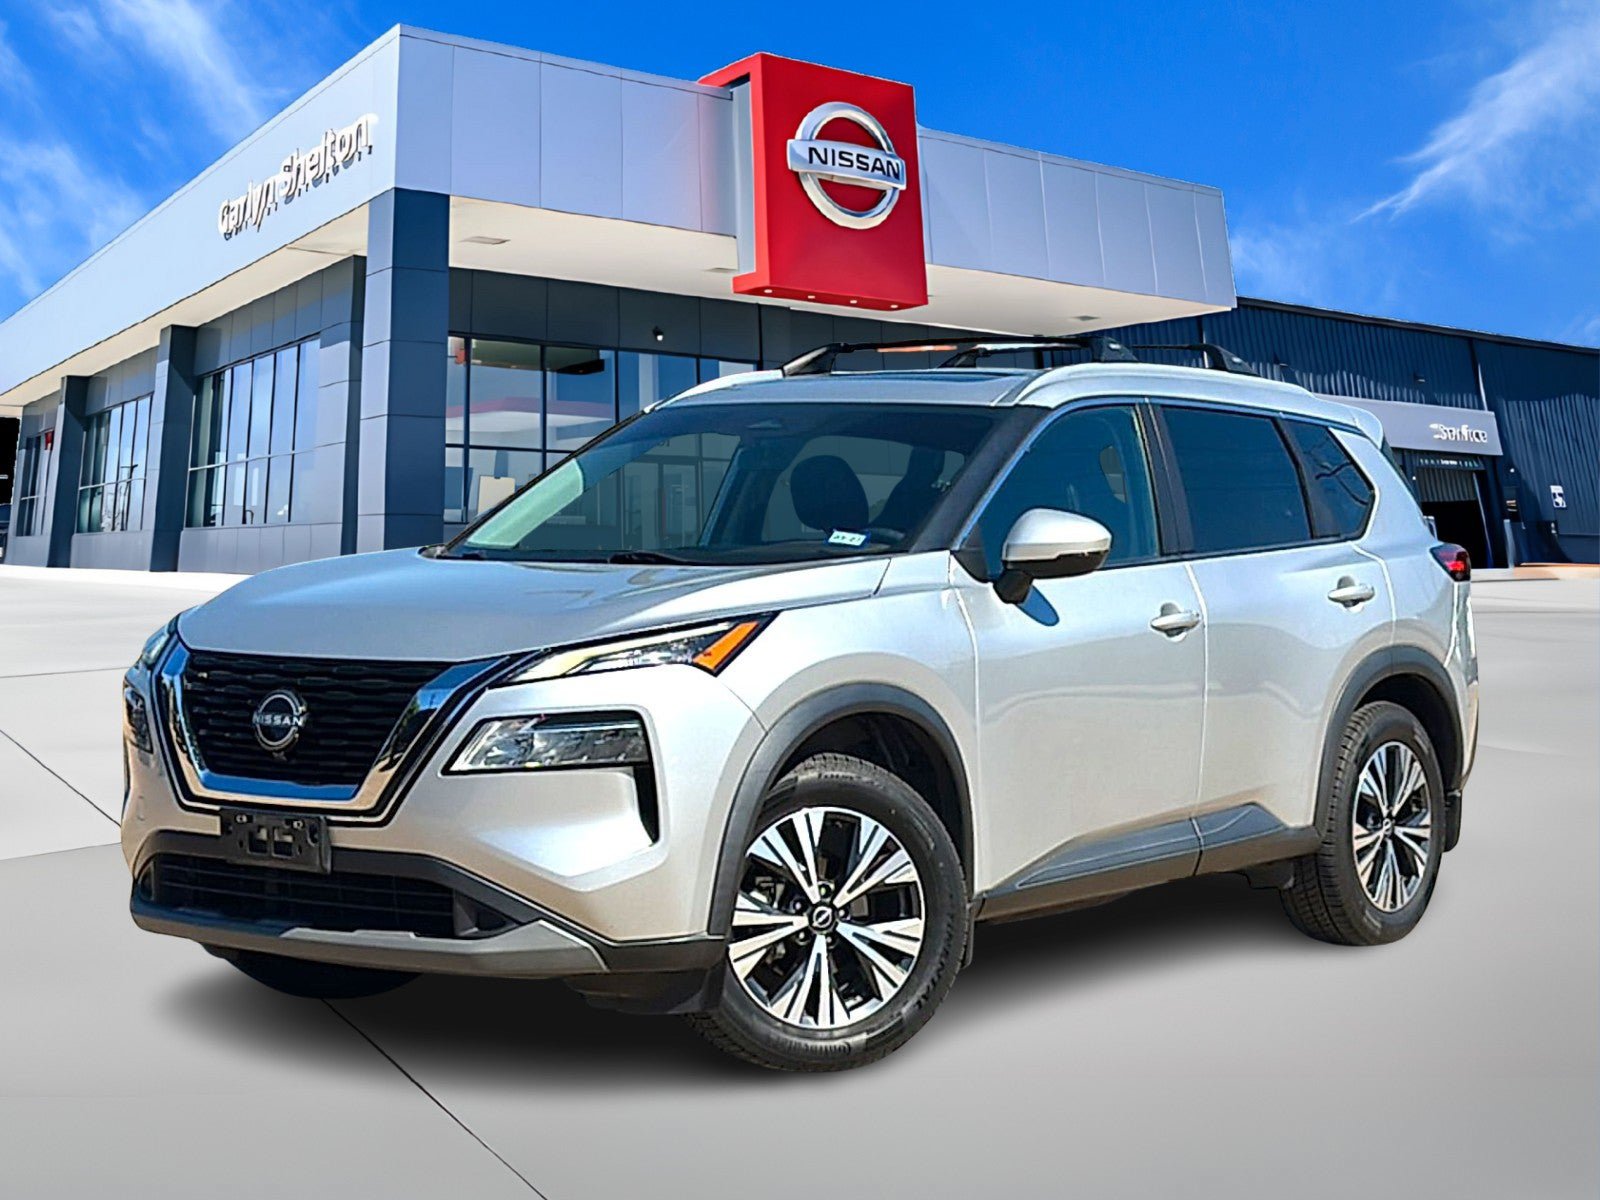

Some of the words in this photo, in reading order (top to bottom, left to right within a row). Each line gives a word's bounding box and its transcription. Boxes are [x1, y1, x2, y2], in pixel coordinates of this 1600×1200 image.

[279, 114, 376, 204] Shelton
[808, 146, 900, 180] NISSAN
[252, 712, 307, 727] NISSAN
